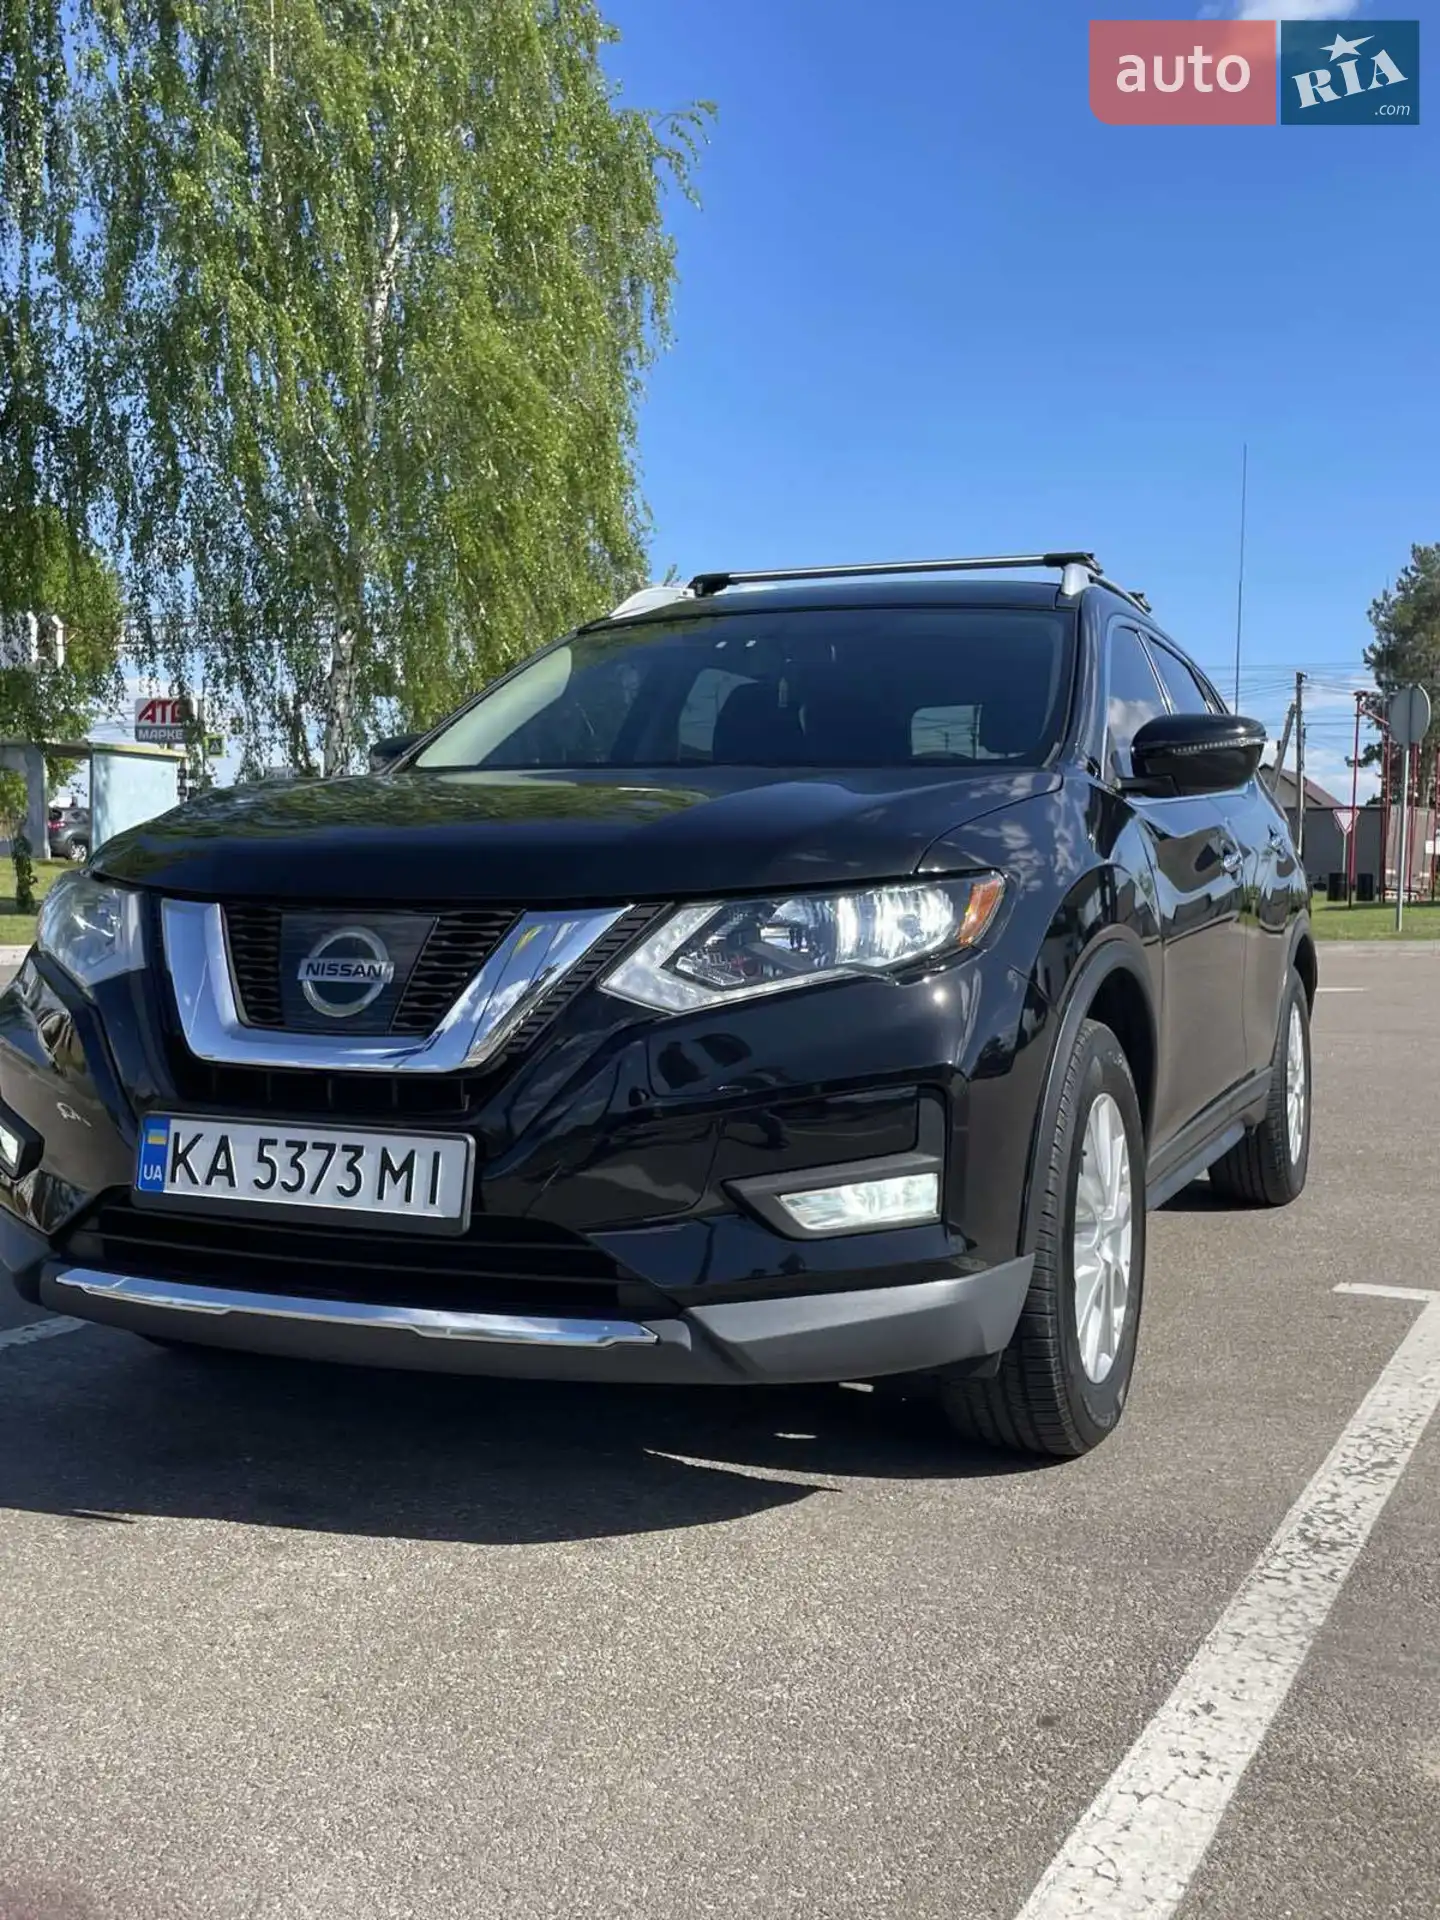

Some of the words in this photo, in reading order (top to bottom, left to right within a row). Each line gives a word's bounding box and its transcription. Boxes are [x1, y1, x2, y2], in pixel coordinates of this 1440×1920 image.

[138, 729, 185, 740] МАРКЕ
[305, 962, 384, 978] NISSAN
[143, 1164, 163, 1182] UA
[169, 1132, 237, 1188] KA
[253, 1138, 365, 1198] 5373
[376, 1147, 441, 1205] MI
